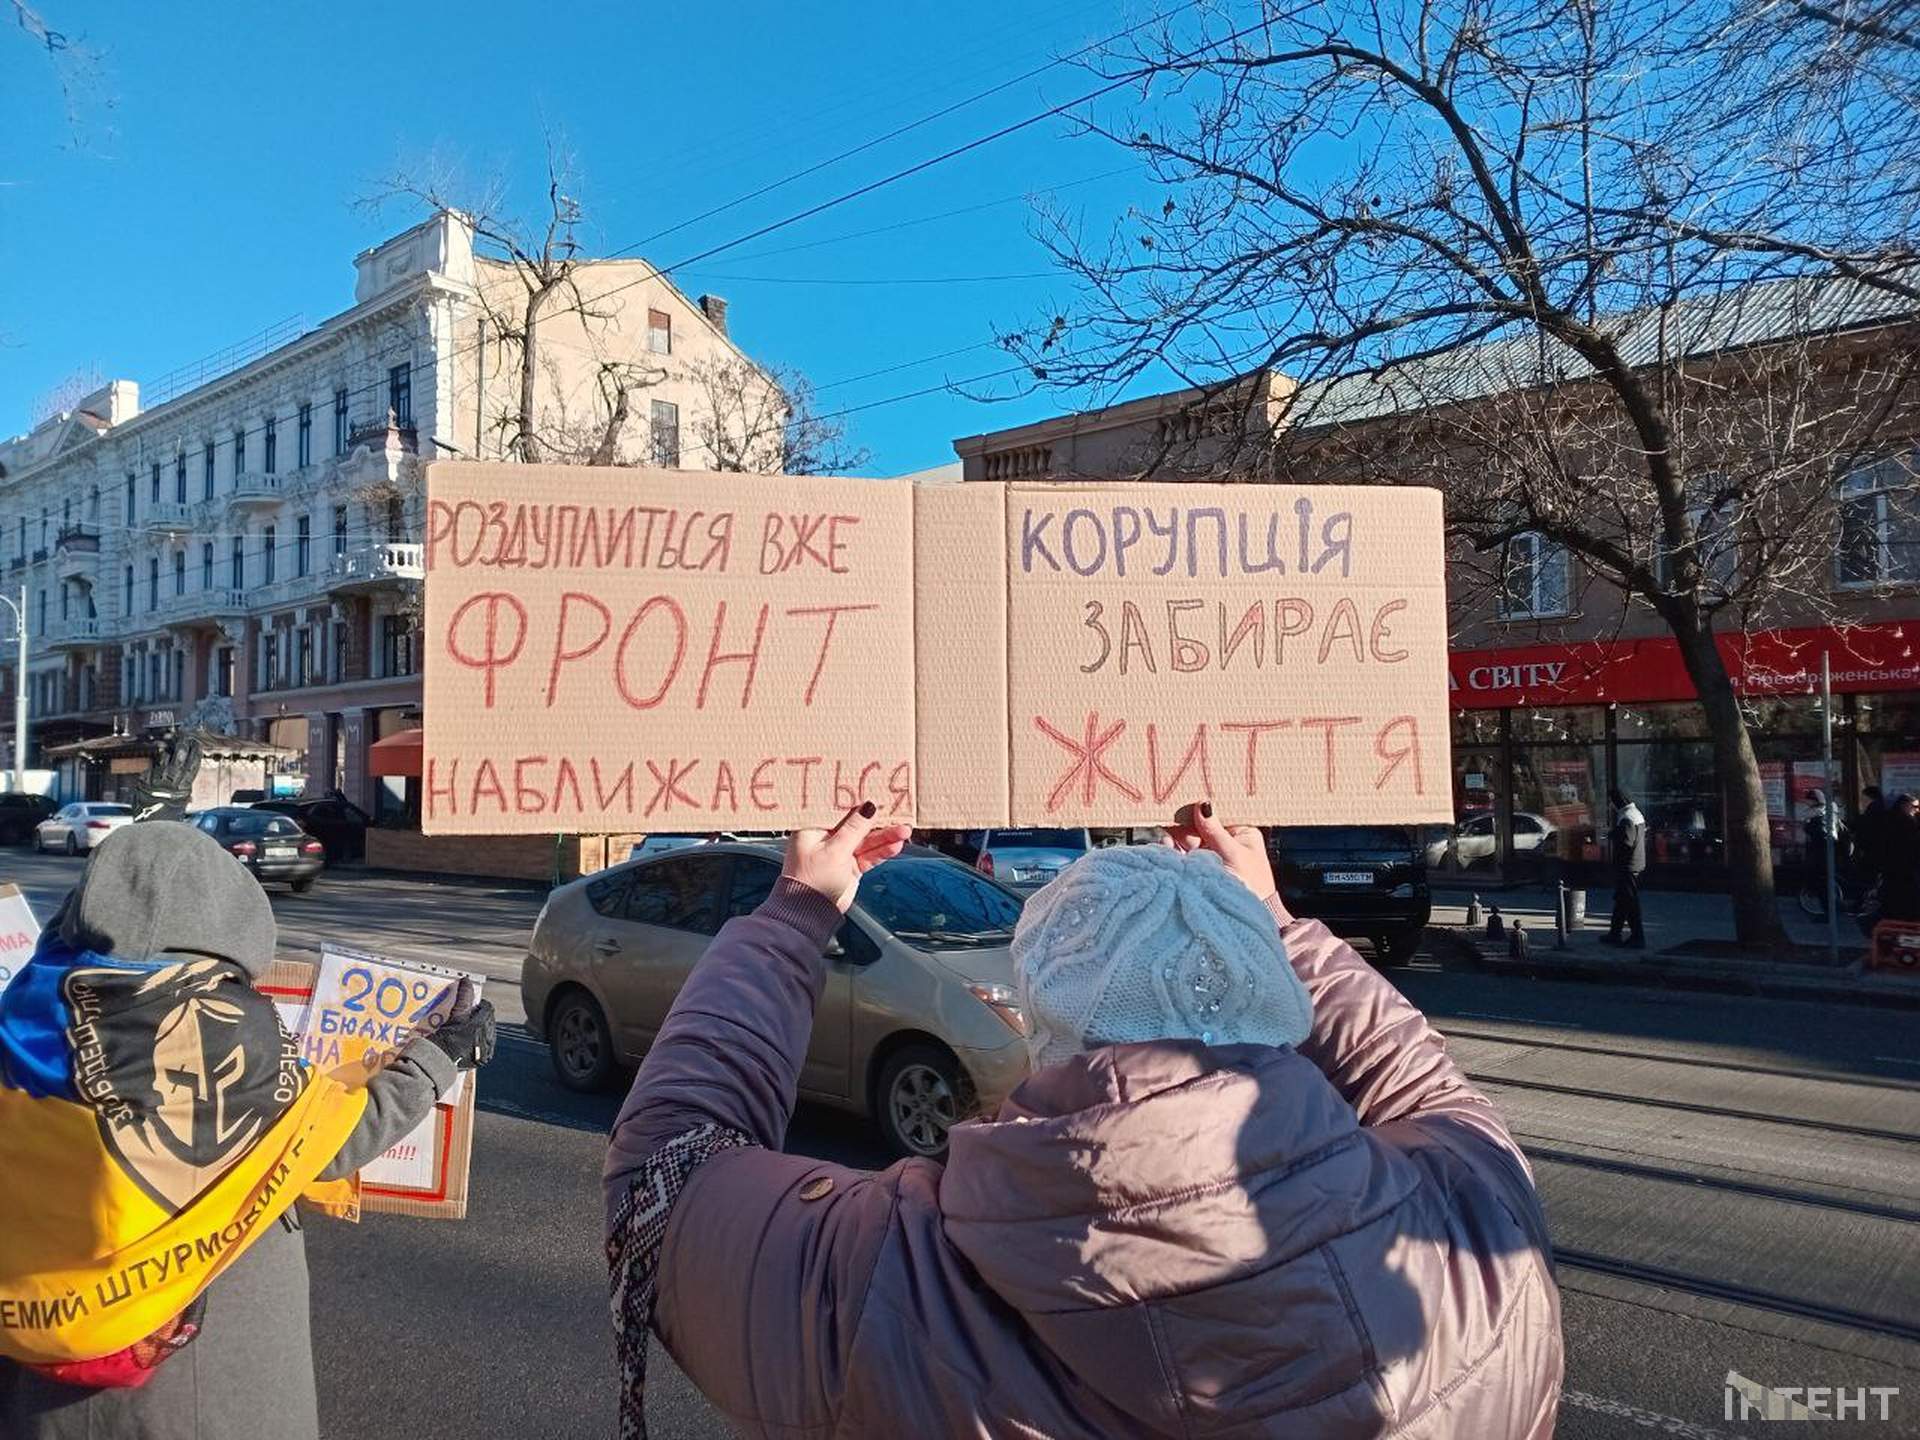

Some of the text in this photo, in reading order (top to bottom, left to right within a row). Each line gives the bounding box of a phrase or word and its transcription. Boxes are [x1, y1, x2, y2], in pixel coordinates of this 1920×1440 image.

[427, 500, 860, 575] РОЗДУПЛИТЬСЯ ВЖЕ
[1021, 498, 1353, 577] КОРУПЦІЯ
[446, 592, 879, 709] ФРОНТ
[1079, 598, 1409, 675] ЗАБИРАЄ
[1469, 662, 1566, 690] СВІТУ
[426, 755, 914, 818] НАБЛИЖАЄТЬСЯ
[1034, 711, 1424, 813] ЖИТТЯ
[341, 967, 444, 1029] 20%
[304, 1036, 340, 1065] НА
